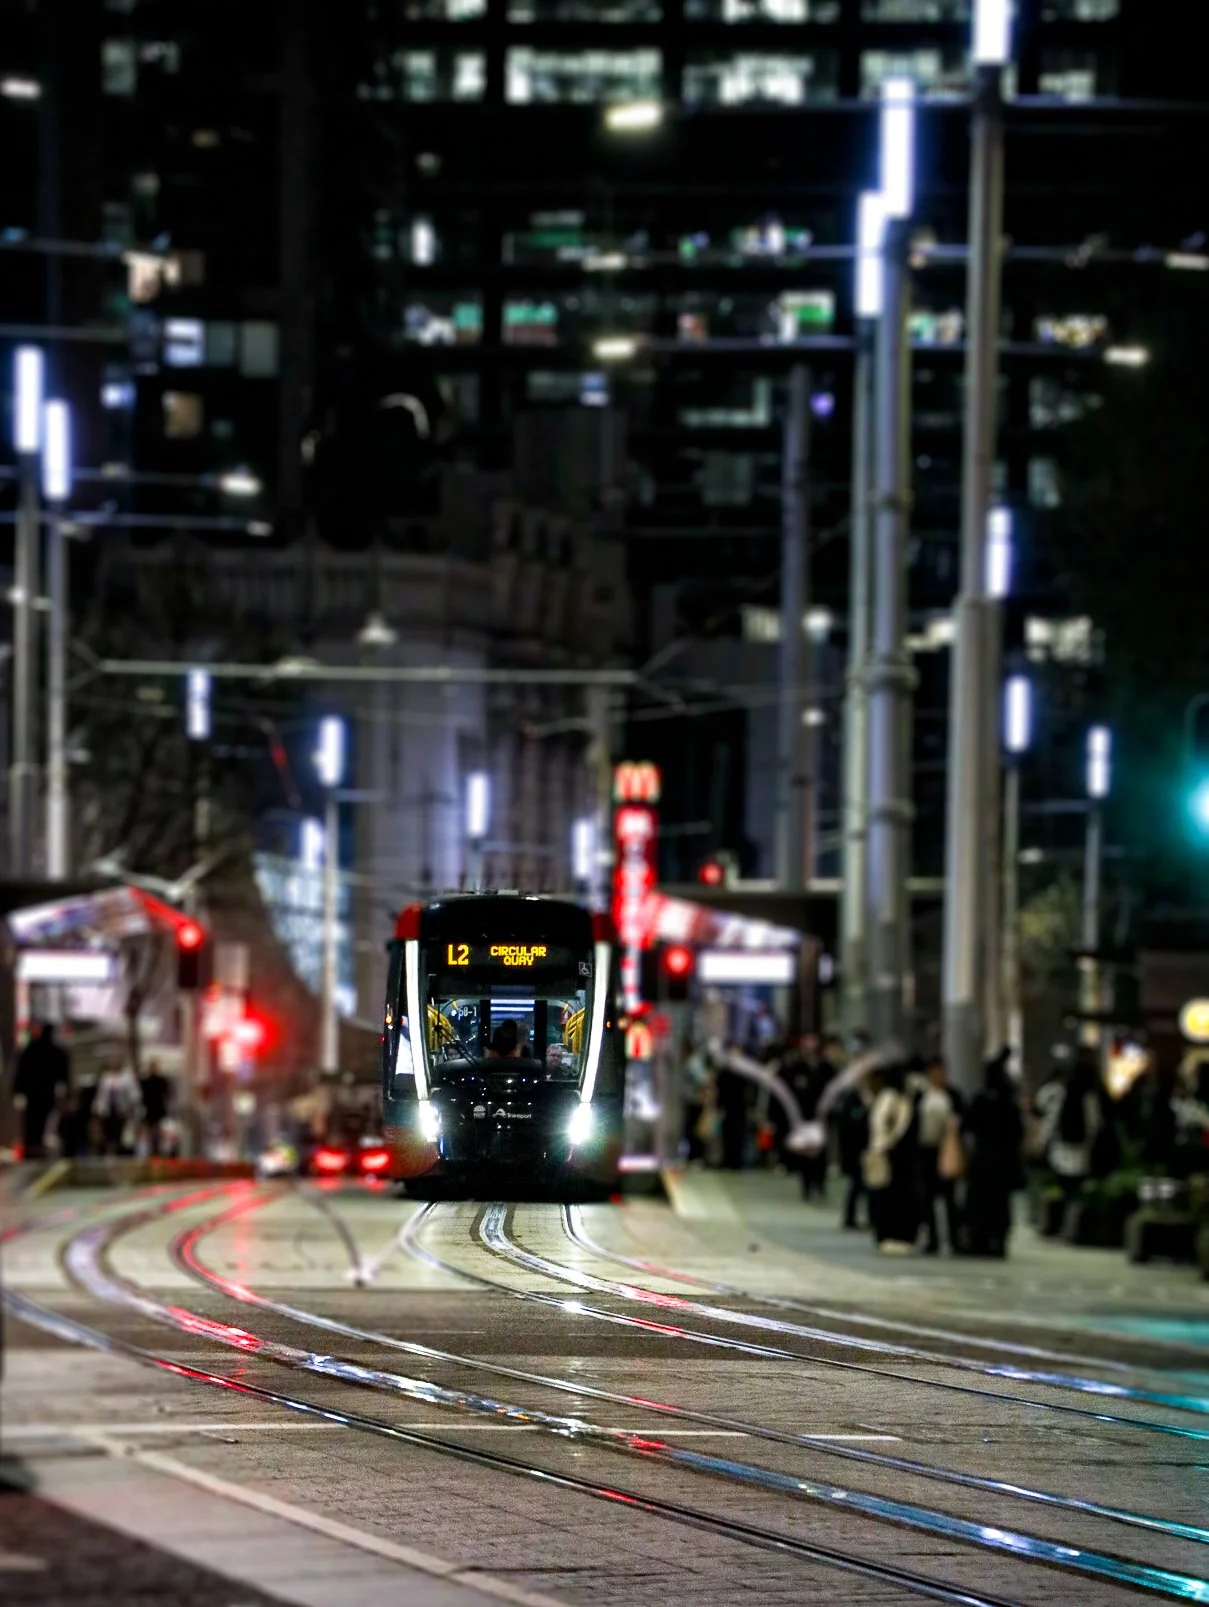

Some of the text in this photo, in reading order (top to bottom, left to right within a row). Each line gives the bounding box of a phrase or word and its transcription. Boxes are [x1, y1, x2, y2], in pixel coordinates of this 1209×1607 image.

[447, 944, 470, 966] L2
[490, 946, 547, 957] CIRCULAR
[503, 956, 534, 966] QUAY
